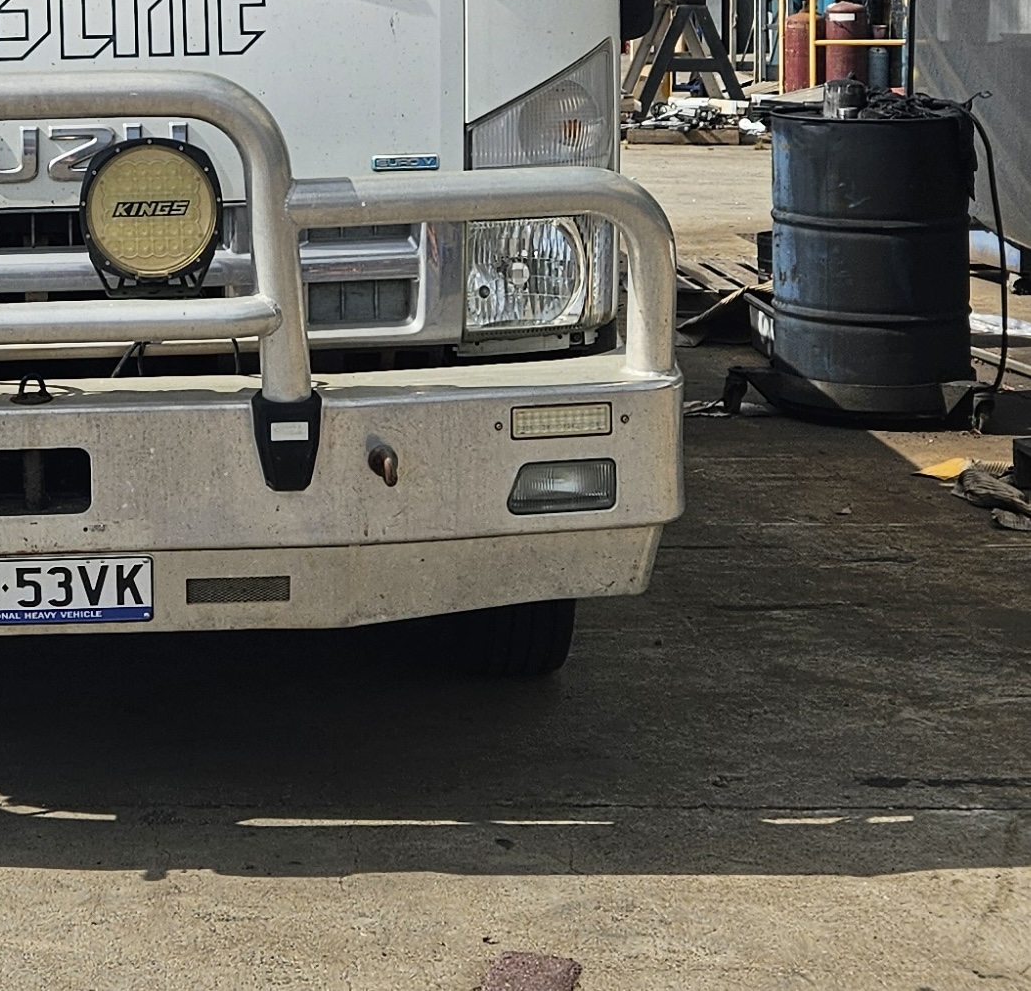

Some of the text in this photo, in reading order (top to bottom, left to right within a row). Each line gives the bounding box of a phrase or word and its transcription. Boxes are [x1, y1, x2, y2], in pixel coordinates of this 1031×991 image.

[112, 200, 190, 218] KINGS
[24, 611, 57, 620] HEAVY
[60, 610, 103, 619] VEHICLE
